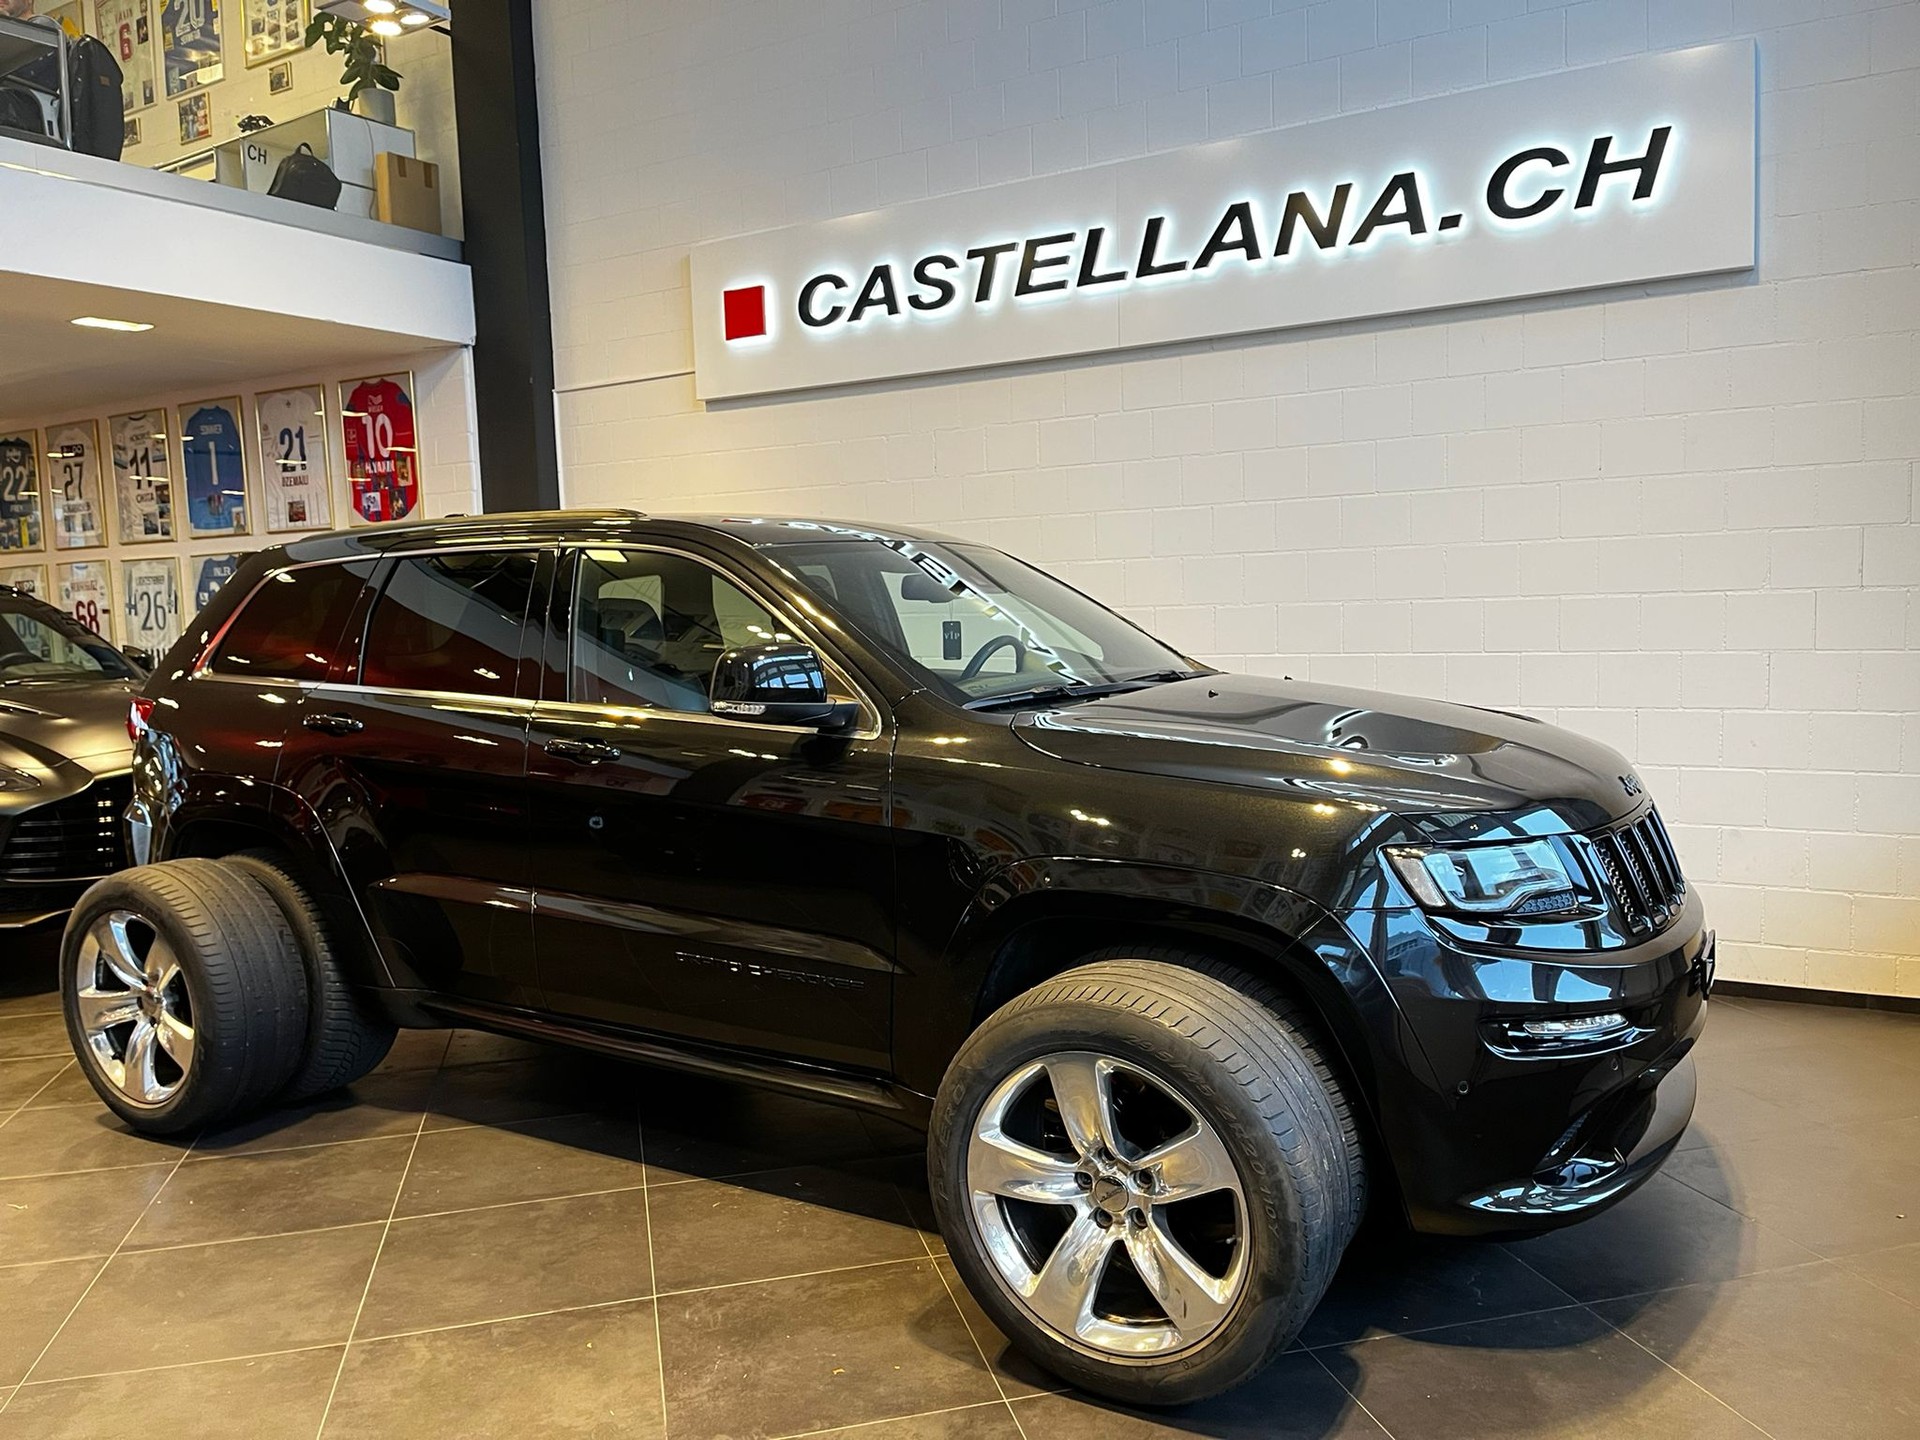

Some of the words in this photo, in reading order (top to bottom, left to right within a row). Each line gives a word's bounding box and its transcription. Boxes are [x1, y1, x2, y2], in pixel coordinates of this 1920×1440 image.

[119, 22, 132, 62] 6
[248, 144, 267, 165] CH
[797, 126, 1673, 327] CASTELLANA.CH
[279, 426, 306, 472] 21
[362, 413, 392, 458] 10
[3, 466, 28, 501] 22
[64, 463, 83, 501] 27
[129, 447, 152, 489] 11
[139, 591, 167, 631] 26
